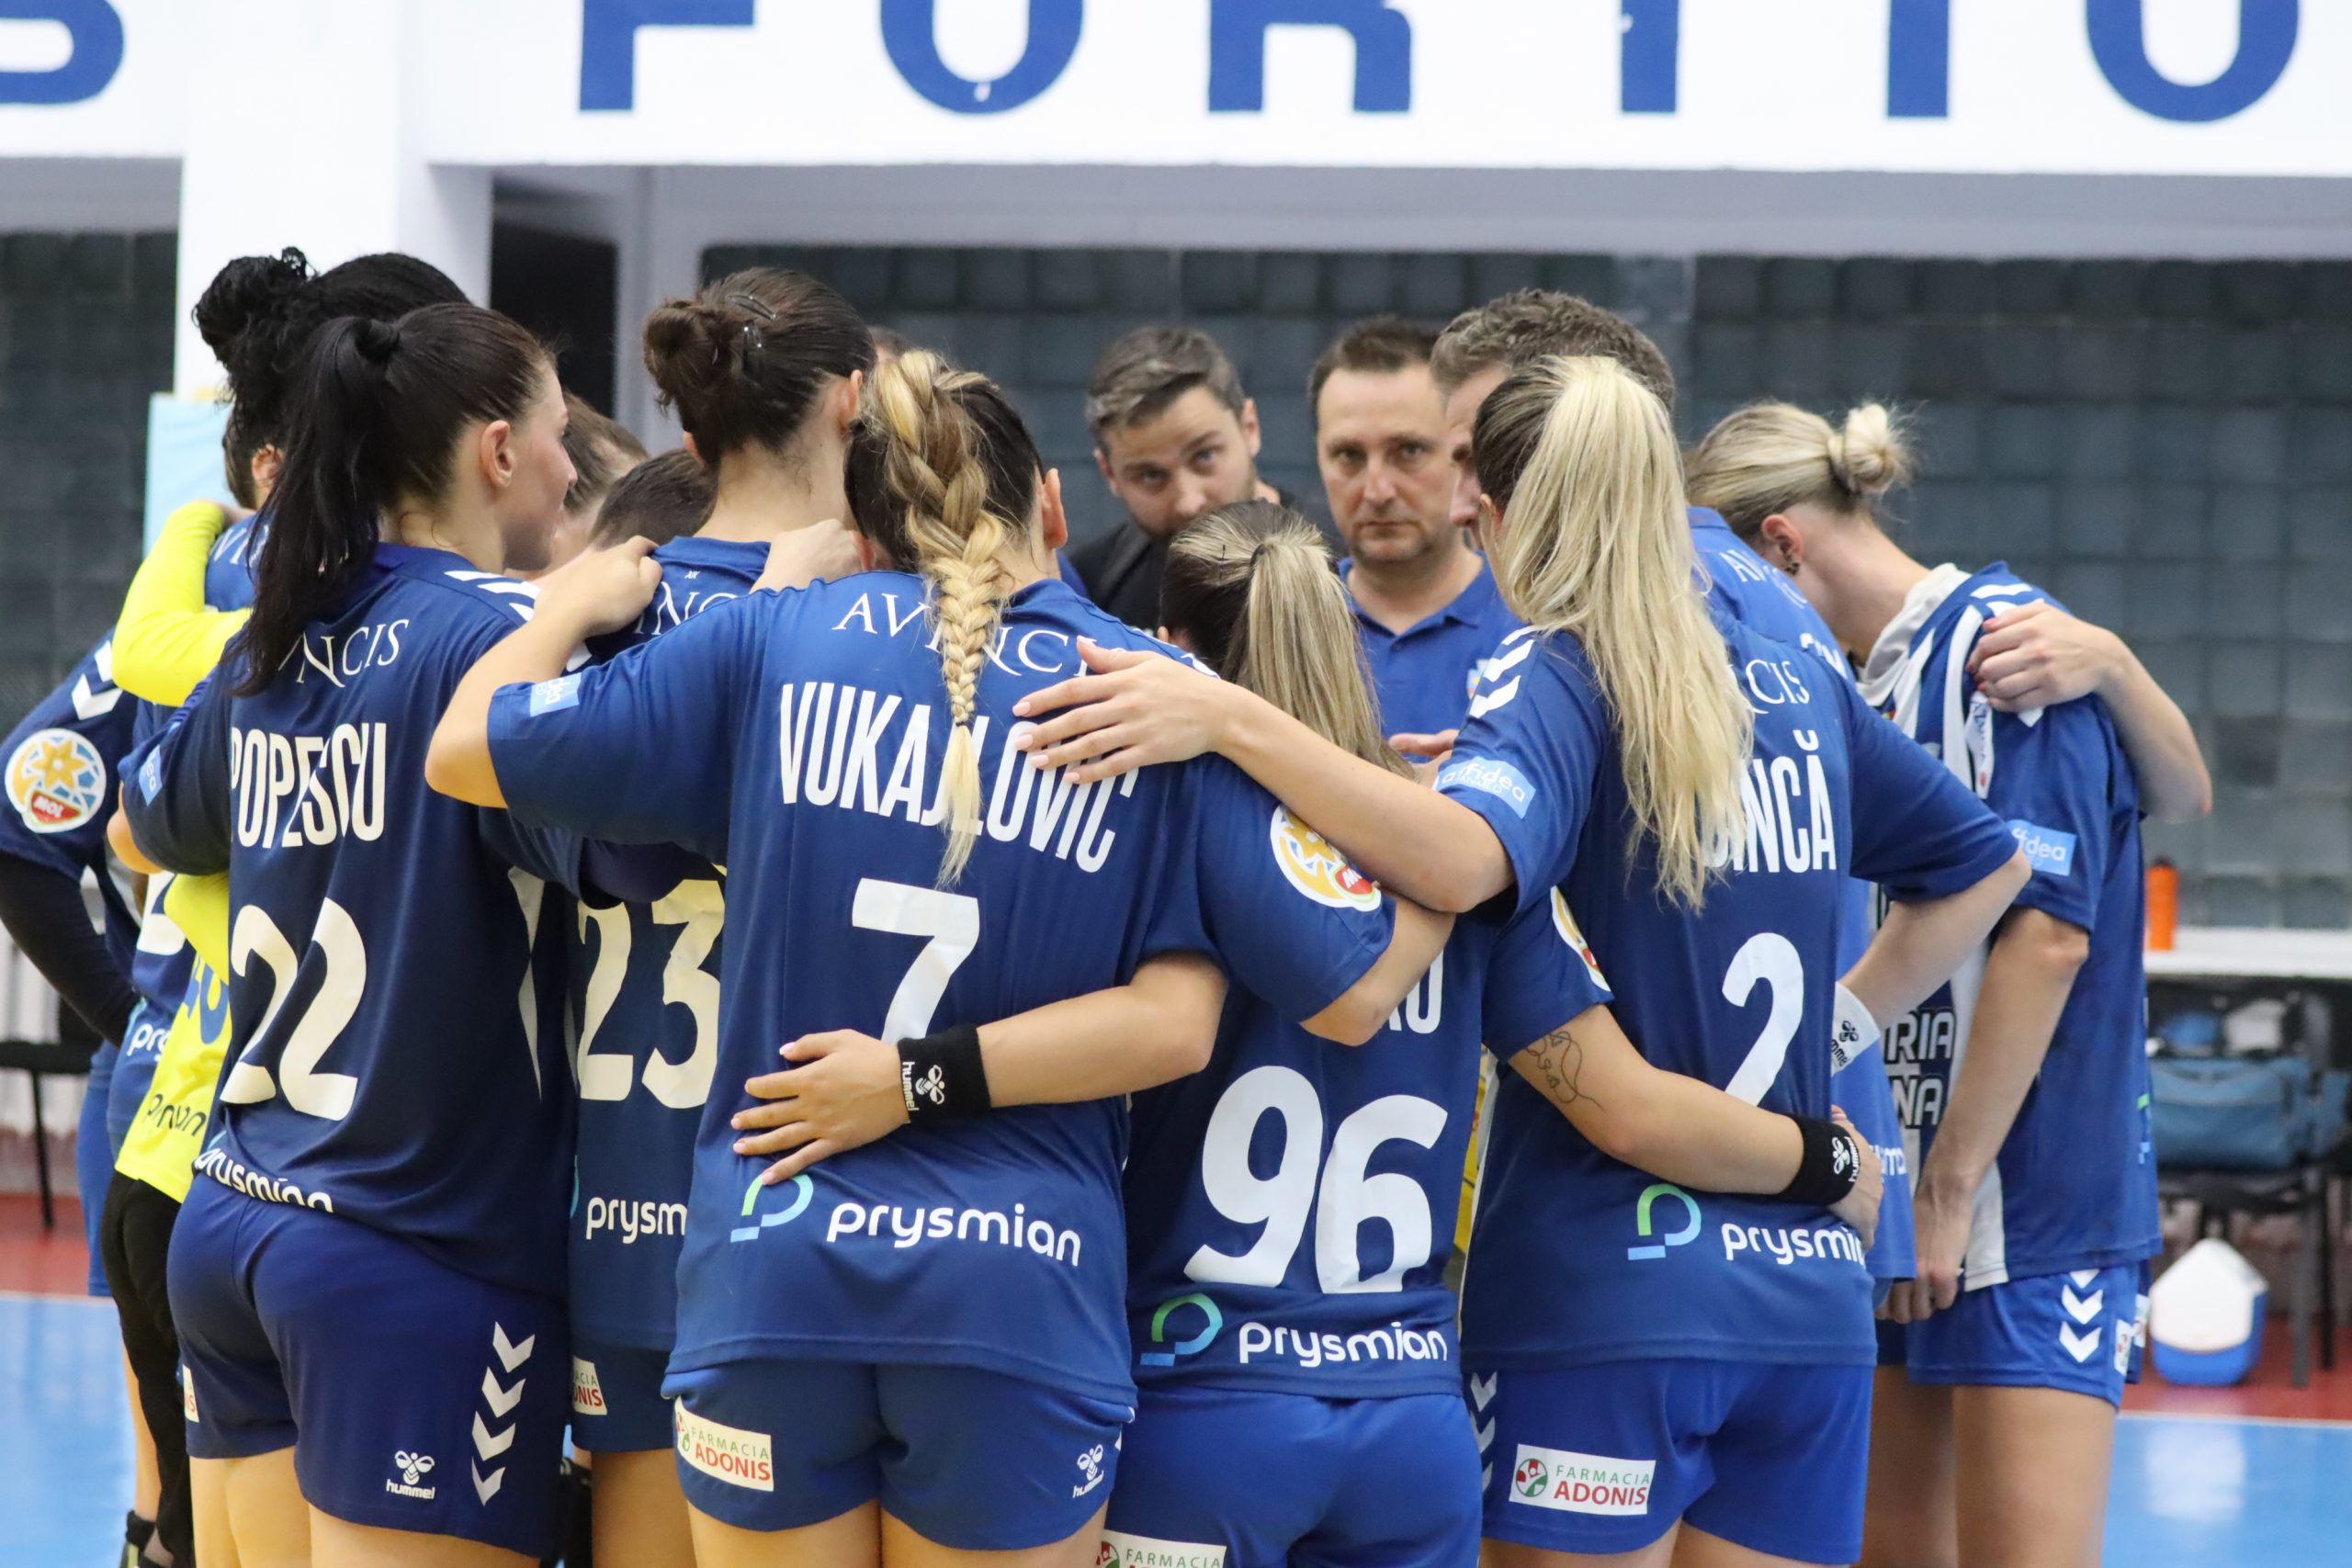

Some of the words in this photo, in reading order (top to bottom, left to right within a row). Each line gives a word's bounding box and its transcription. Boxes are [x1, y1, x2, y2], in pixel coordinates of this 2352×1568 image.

[852, 878, 980, 1043] 7
[220, 897, 367, 1121] 22
[577, 879, 726, 1110] 23
[1722, 932, 1804, 1106] 2
[901, 1061, 920, 1111] hummel
[1183, 1066, 1448, 1294] 96
[827, 1203, 1081, 1267] prysmian
[1239, 1321, 1448, 1368] prysmian
[691, 1427, 770, 1461] FARMACIA
[695, 1441, 771, 1482] ADONIS
[386, 1478, 435, 1500] hummel
[1554, 1480, 1647, 1506] ADONIS
[1555, 1465, 1650, 1485] FARMACIA
